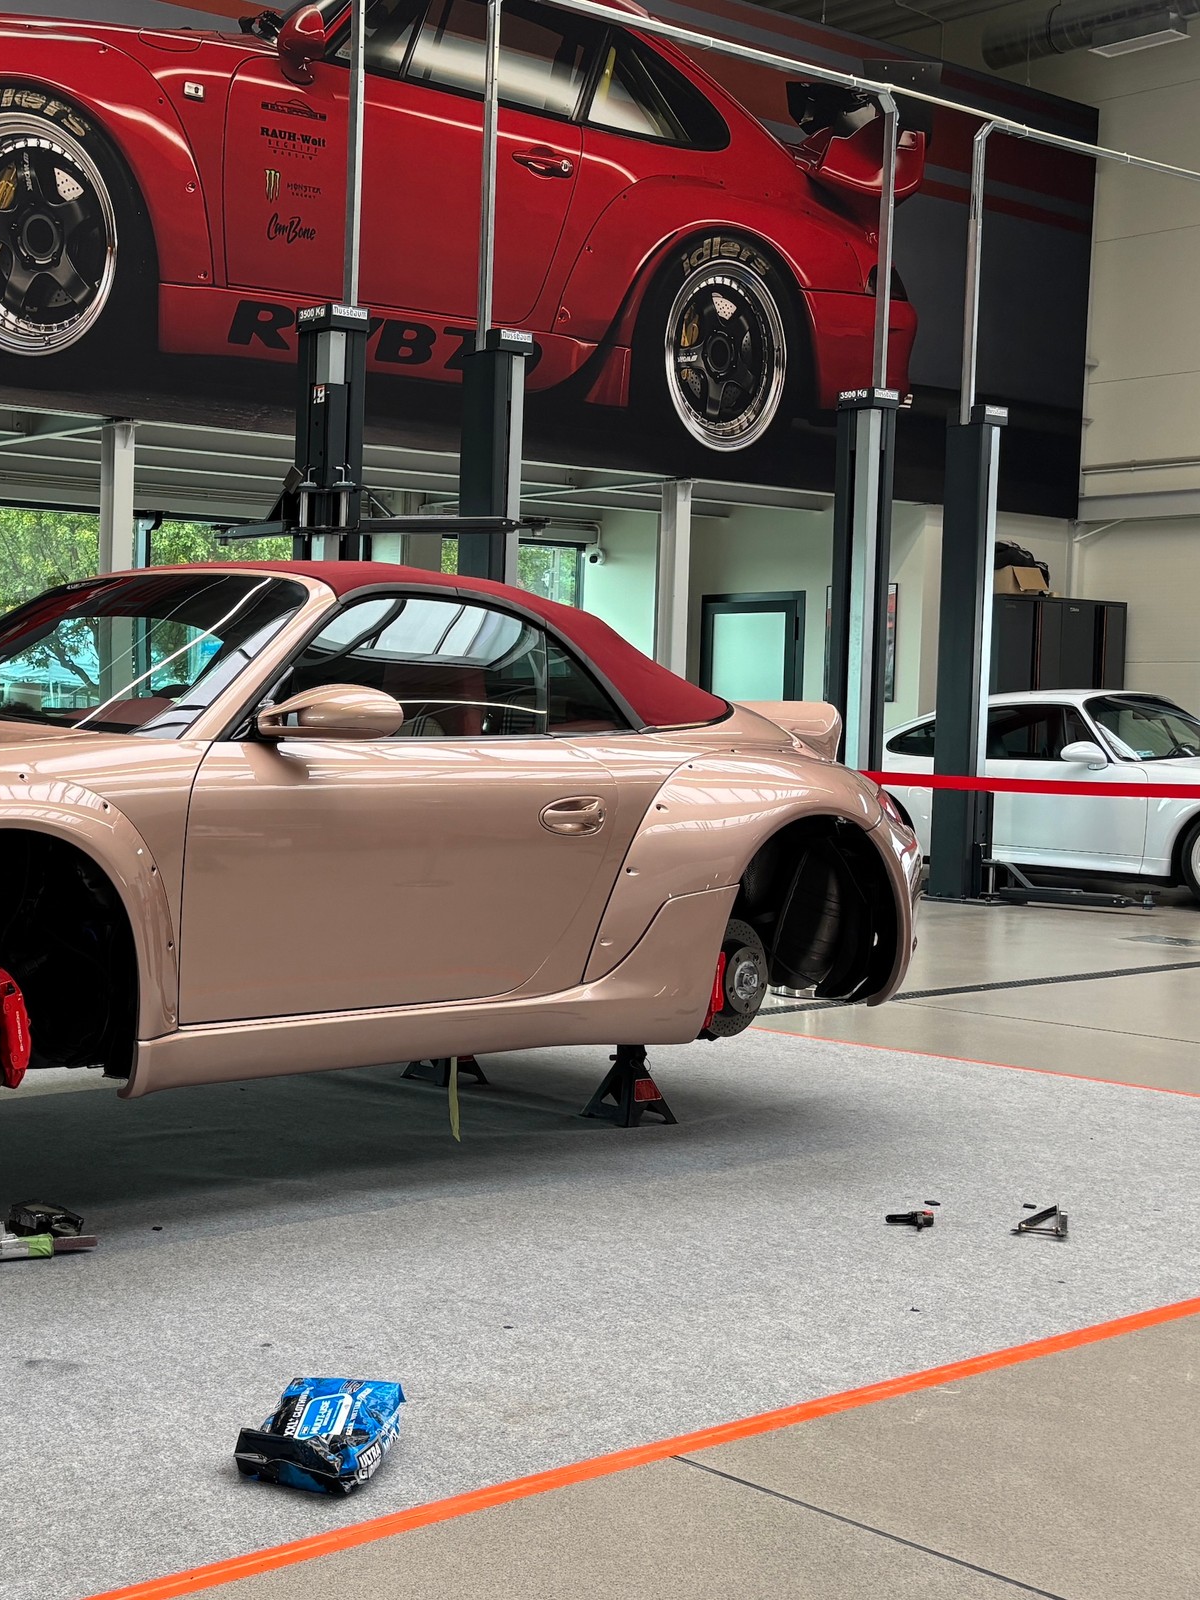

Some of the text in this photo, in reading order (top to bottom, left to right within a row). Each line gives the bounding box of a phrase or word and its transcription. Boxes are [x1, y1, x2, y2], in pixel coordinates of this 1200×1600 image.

[286, 182, 322, 195] MONSTER
[681, 237, 770, 276] idlers
[299, 310, 315, 320] 3500
[840, 389, 868, 400] 3500 Kg
[358, 1442, 382, 1470] ULTRA
